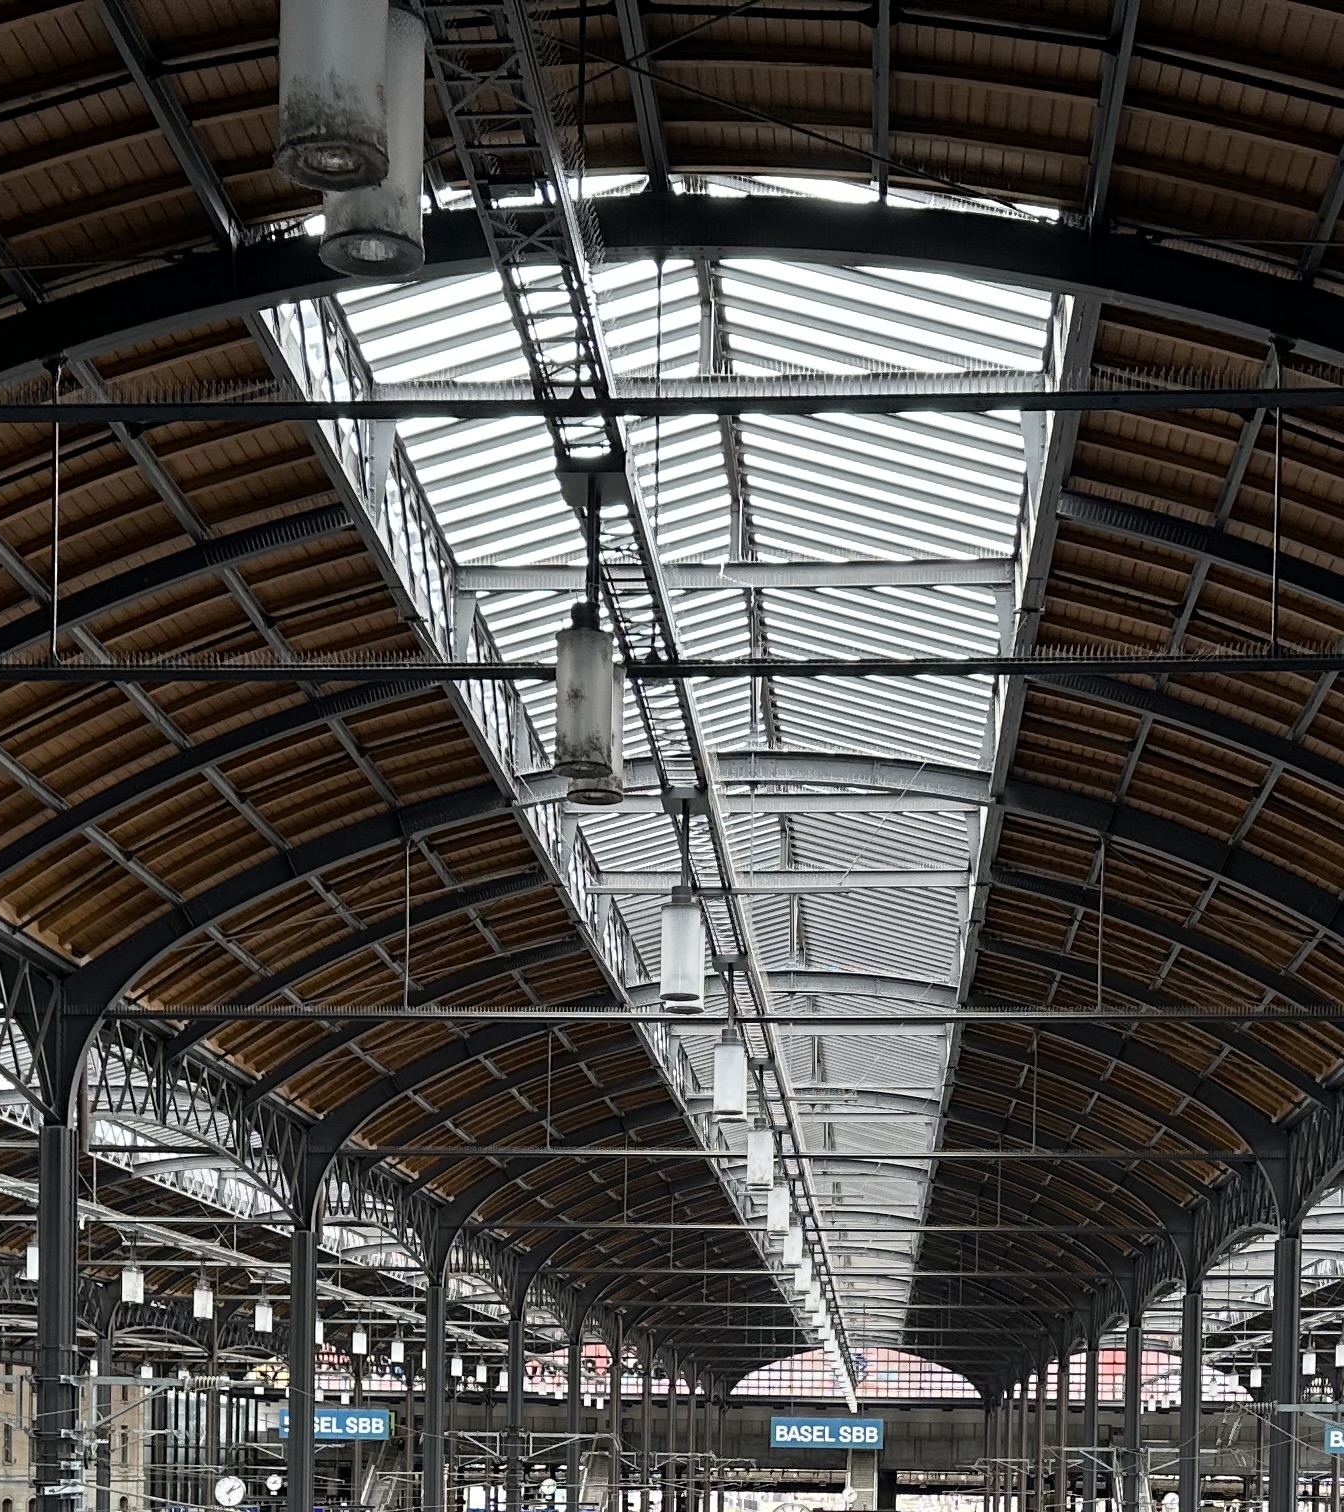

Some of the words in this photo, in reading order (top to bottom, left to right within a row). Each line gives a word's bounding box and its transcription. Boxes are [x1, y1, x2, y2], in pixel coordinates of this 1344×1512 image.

[345, 1416, 385, 1434] SBB
[775, 1425, 836, 1443] BASEL
[838, 1425, 879, 1443] SBB
